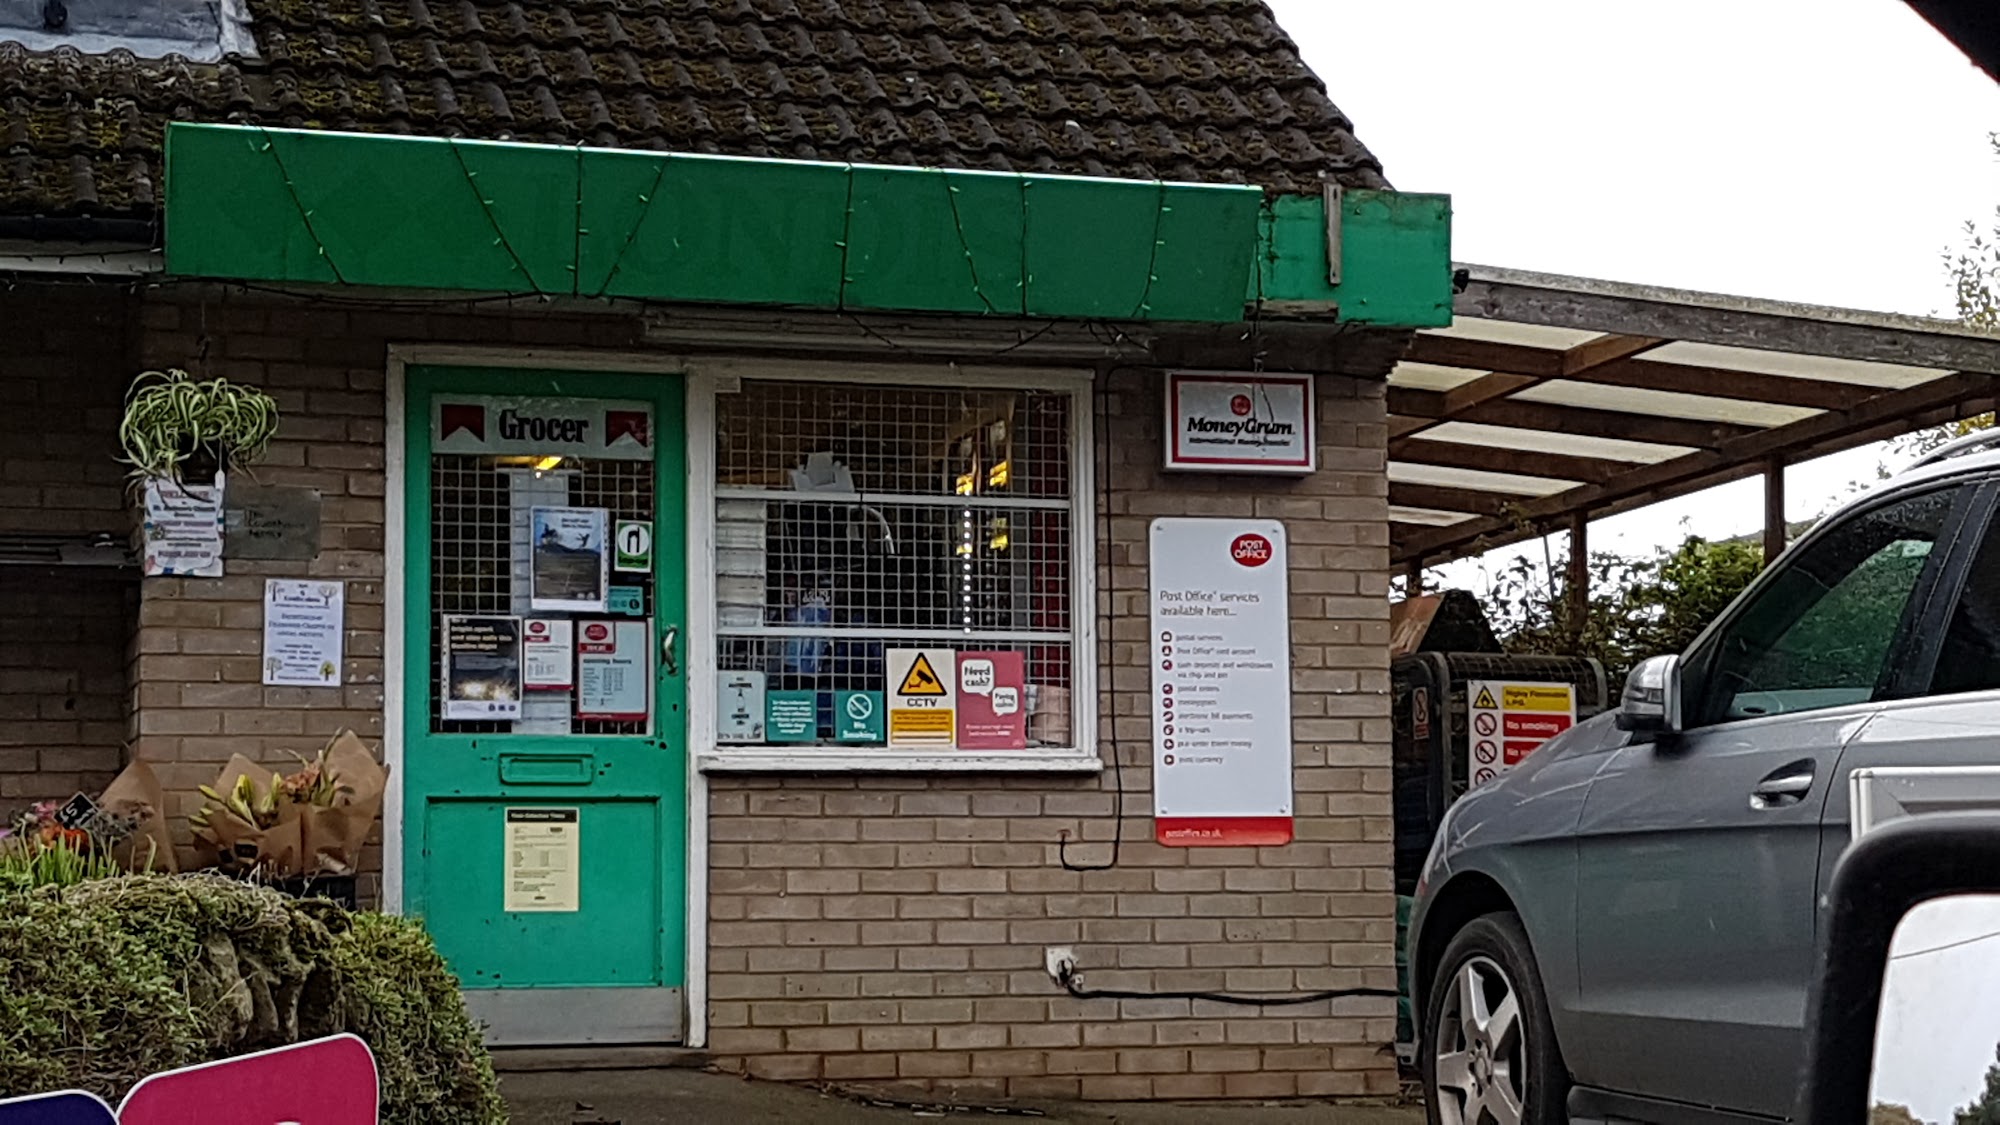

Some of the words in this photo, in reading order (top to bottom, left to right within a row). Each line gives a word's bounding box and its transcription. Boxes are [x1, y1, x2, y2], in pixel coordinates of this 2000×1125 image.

[499, 408, 589, 443] Grocer
[1239, 540, 1264, 549] POST
[1234, 549, 1268, 559] OFFICE
[1160, 590, 1182, 601] Post
[1220, 592, 1260, 603] services
[1160, 605, 1203, 616] available
[964, 666, 990, 676] Need
[965, 677, 990, 687] cash?
[906, 698, 938, 707] CCTV
[1506, 721, 1520, 730] No
[1521, 722, 1559, 733] smoking
[842, 730, 877, 741] Smoking
